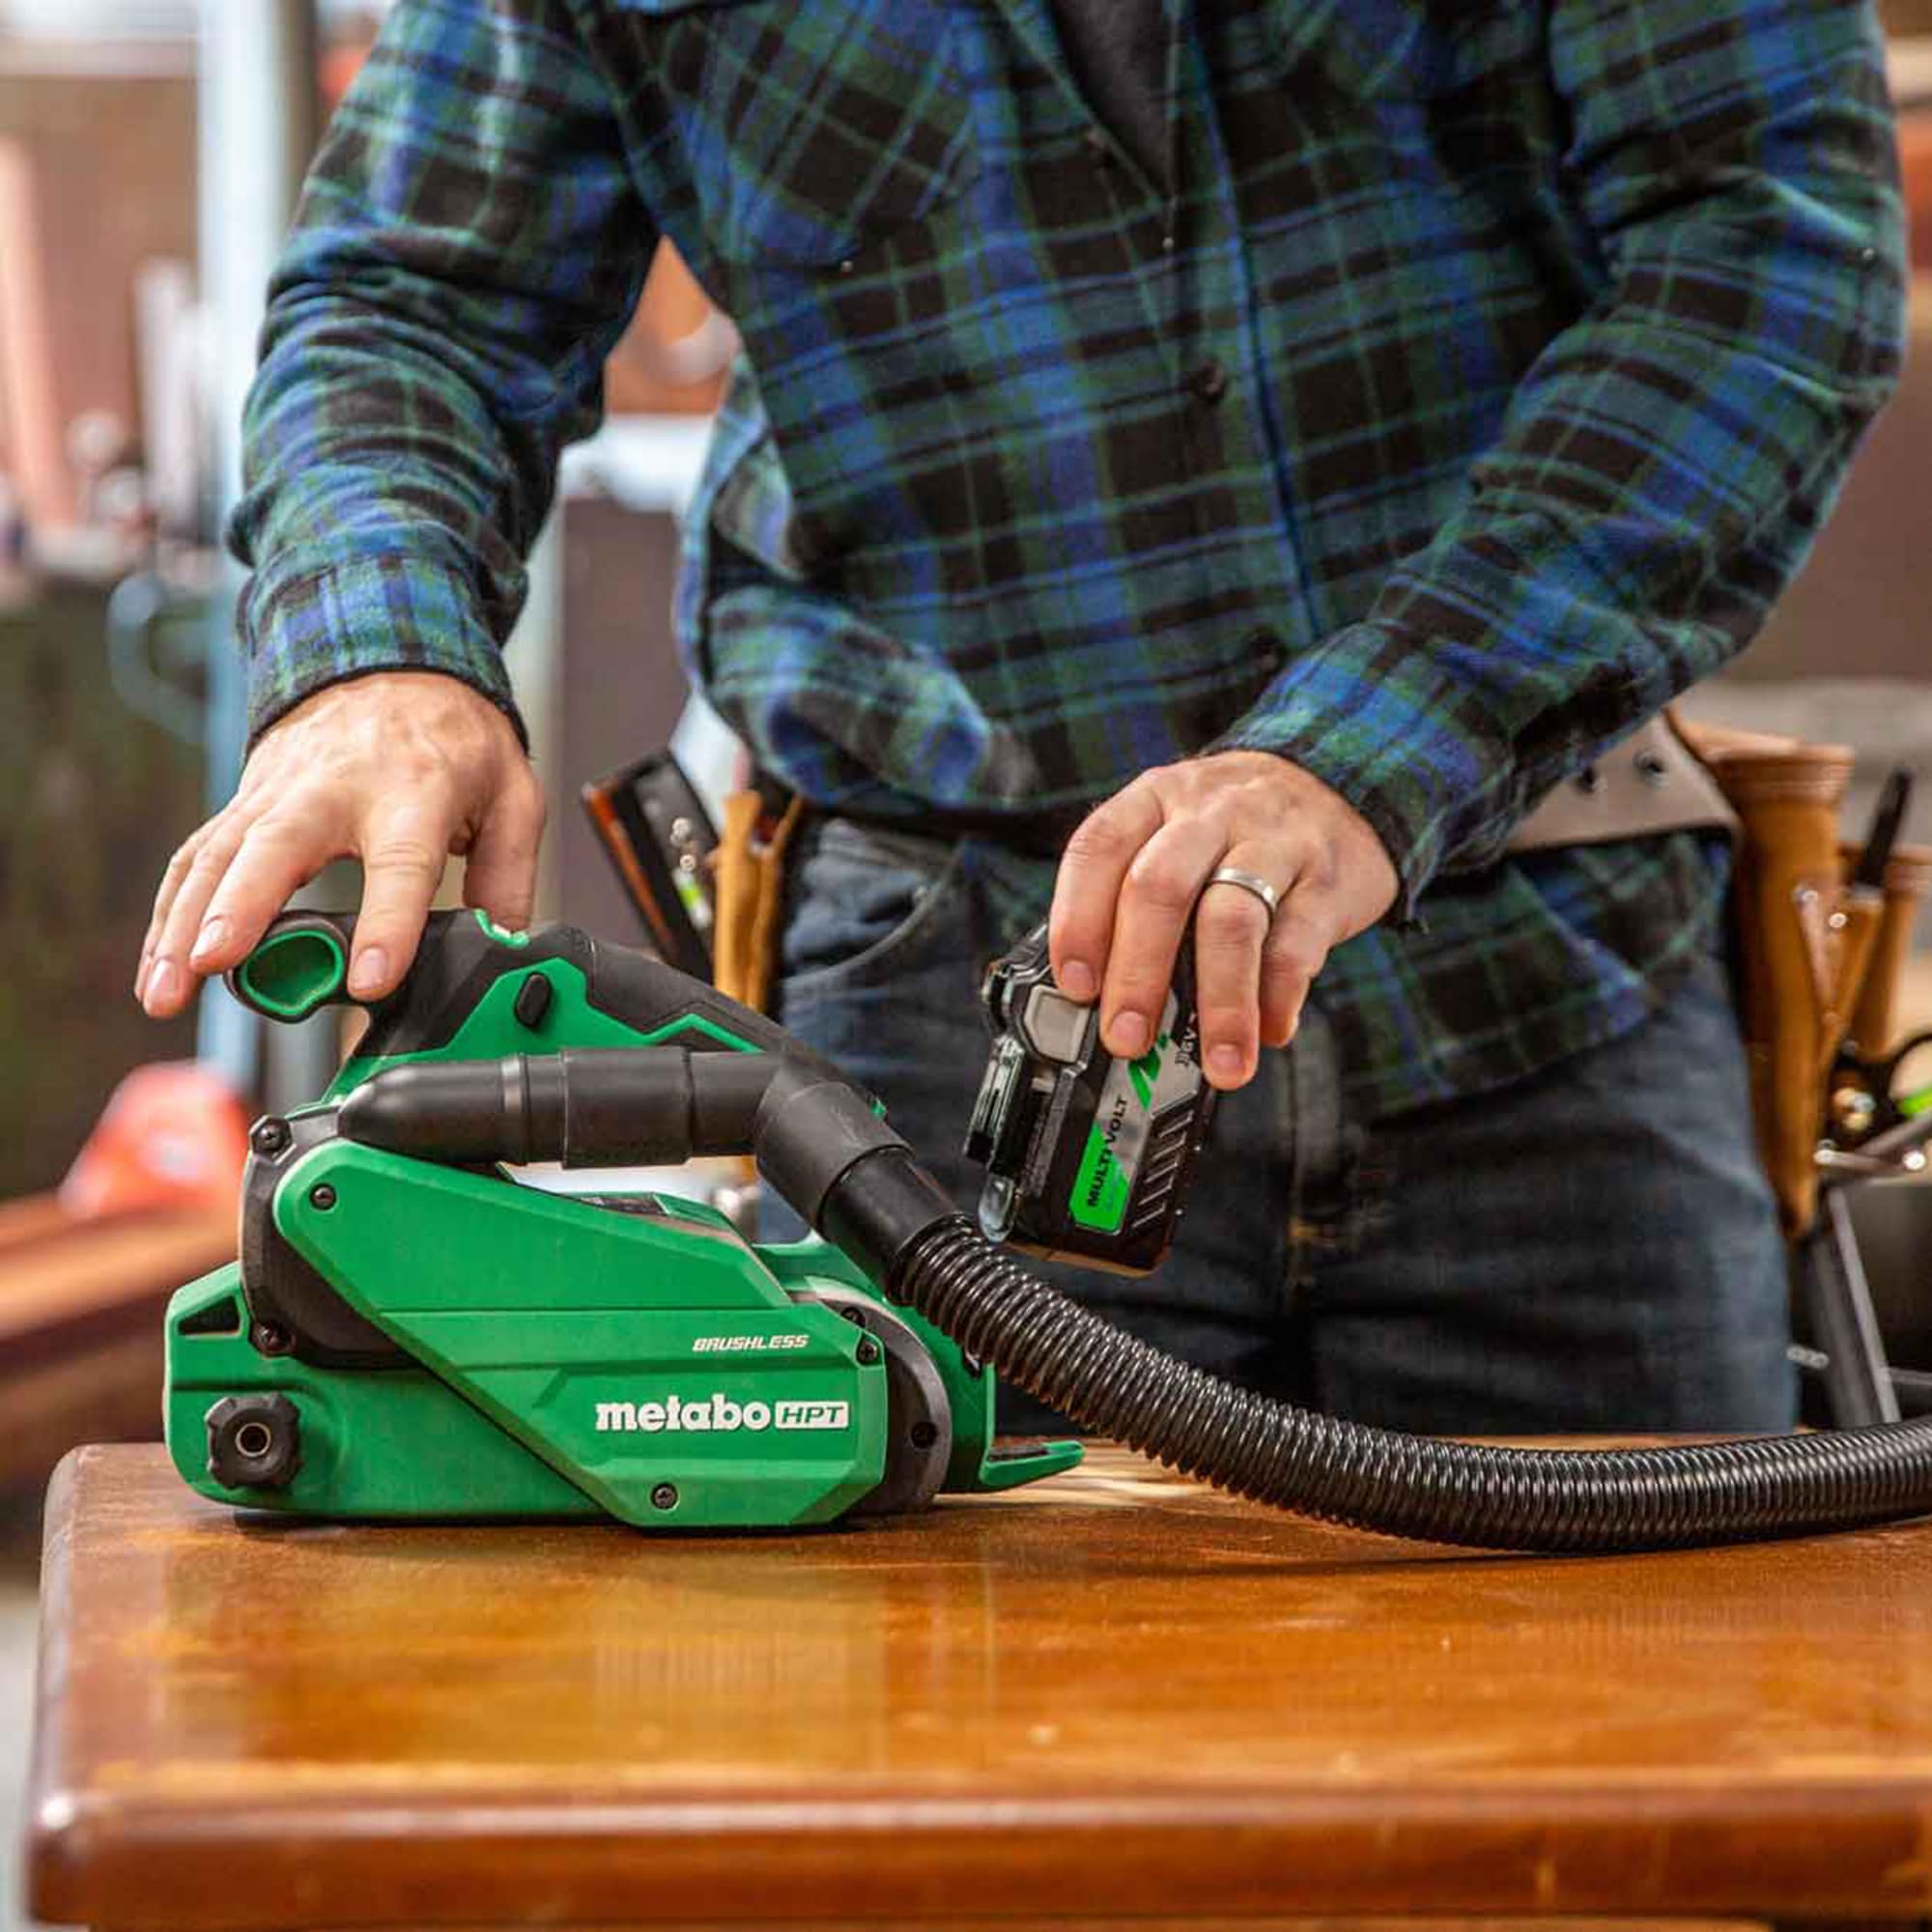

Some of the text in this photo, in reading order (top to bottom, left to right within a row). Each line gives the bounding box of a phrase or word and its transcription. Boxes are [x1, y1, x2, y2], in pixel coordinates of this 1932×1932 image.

[692, 1335, 810, 1352] BRUSHLESS
[595, 1393, 845, 1432] metabo HPT
